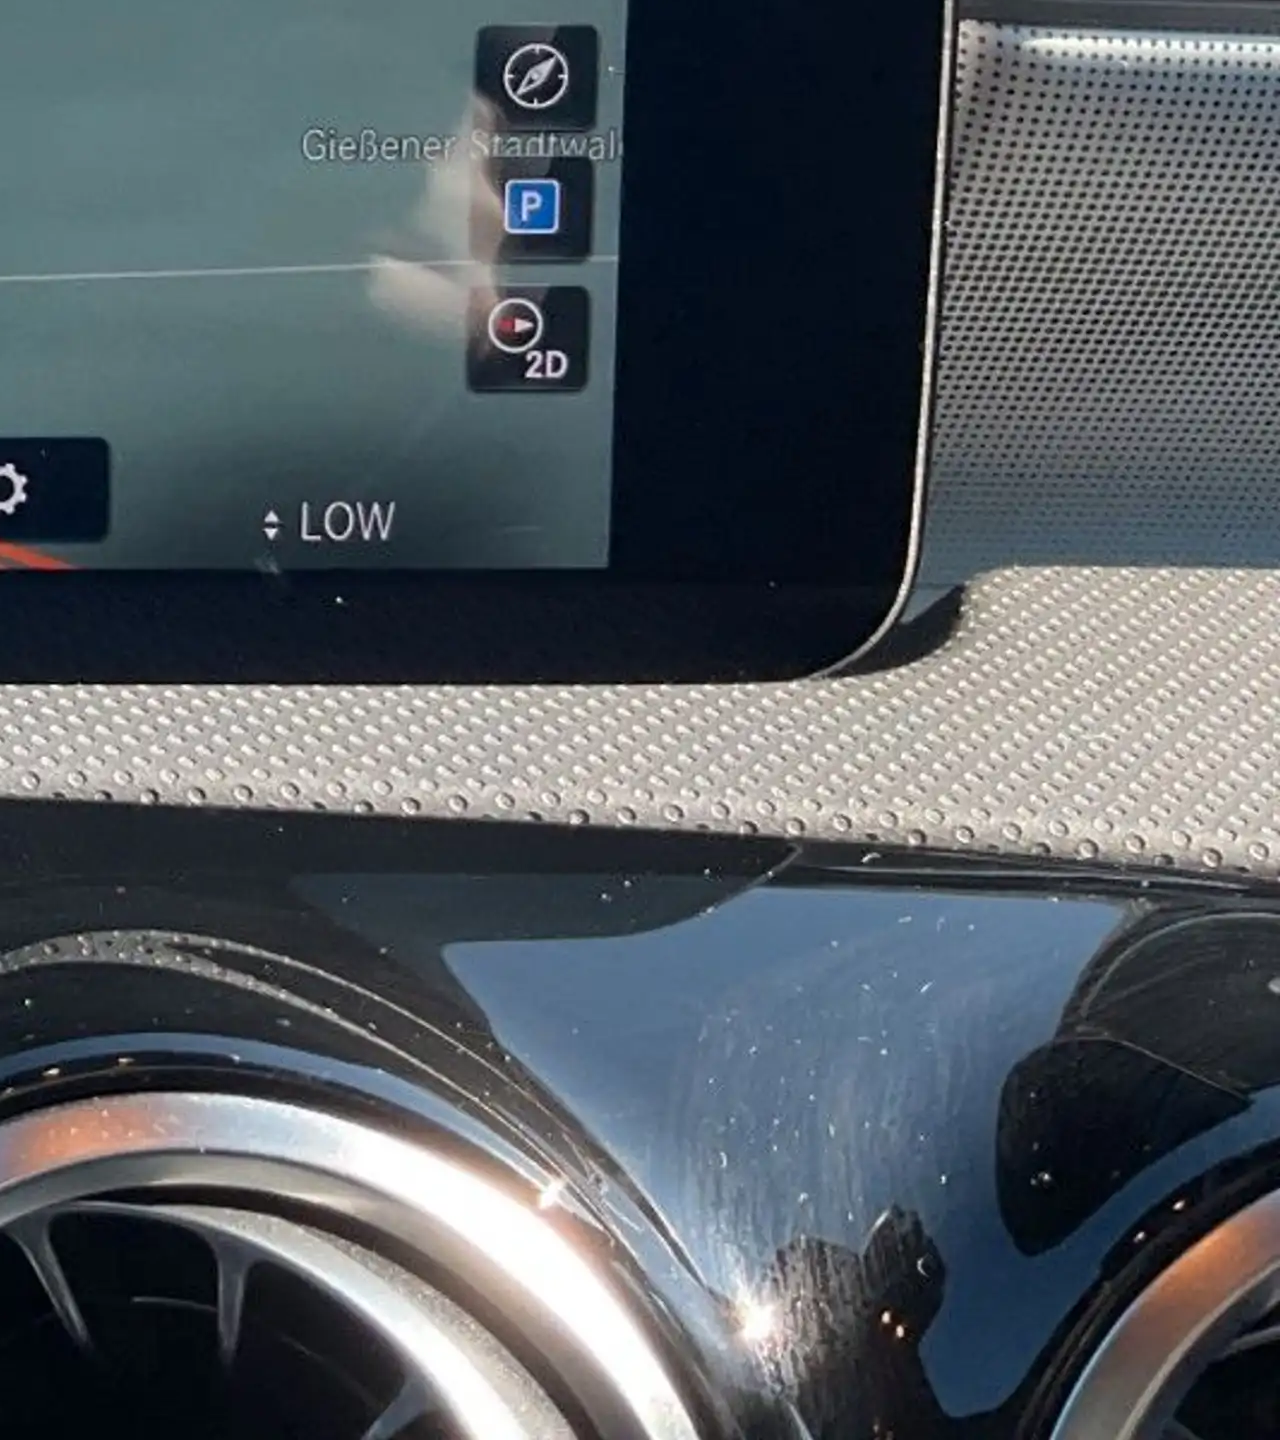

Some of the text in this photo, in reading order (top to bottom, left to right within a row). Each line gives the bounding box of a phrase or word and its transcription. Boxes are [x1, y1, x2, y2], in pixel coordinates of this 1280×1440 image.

[301, 129, 457, 162] Gießener
[520, 190, 543, 222] P
[524, 349, 569, 379] 2D
[300, 501, 396, 541] LOW
